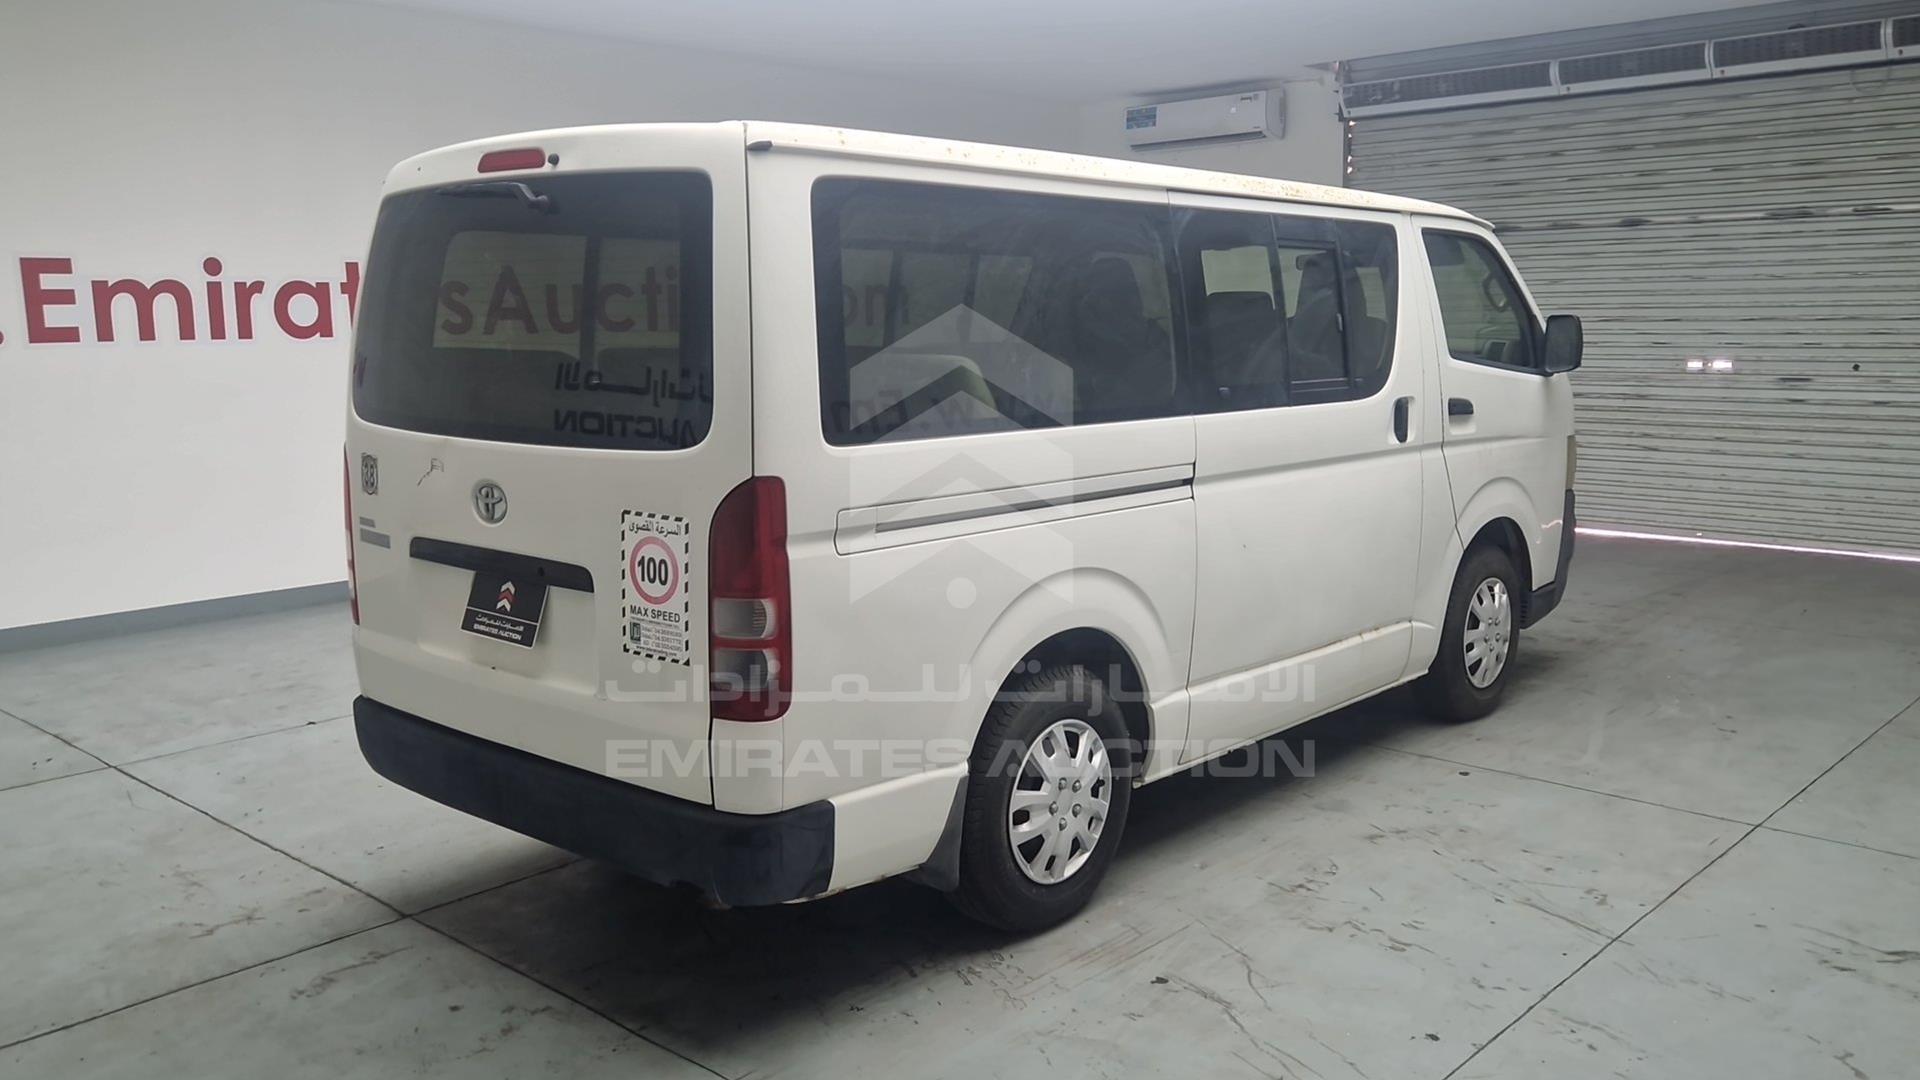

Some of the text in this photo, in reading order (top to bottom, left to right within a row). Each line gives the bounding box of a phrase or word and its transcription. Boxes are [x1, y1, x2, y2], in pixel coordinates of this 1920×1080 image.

[638, 555, 668, 586] 100
[630, 604, 649, 617] MAX
[651, 608, 680, 623] SPEED
[500, 630, 522, 640] AUCTION
